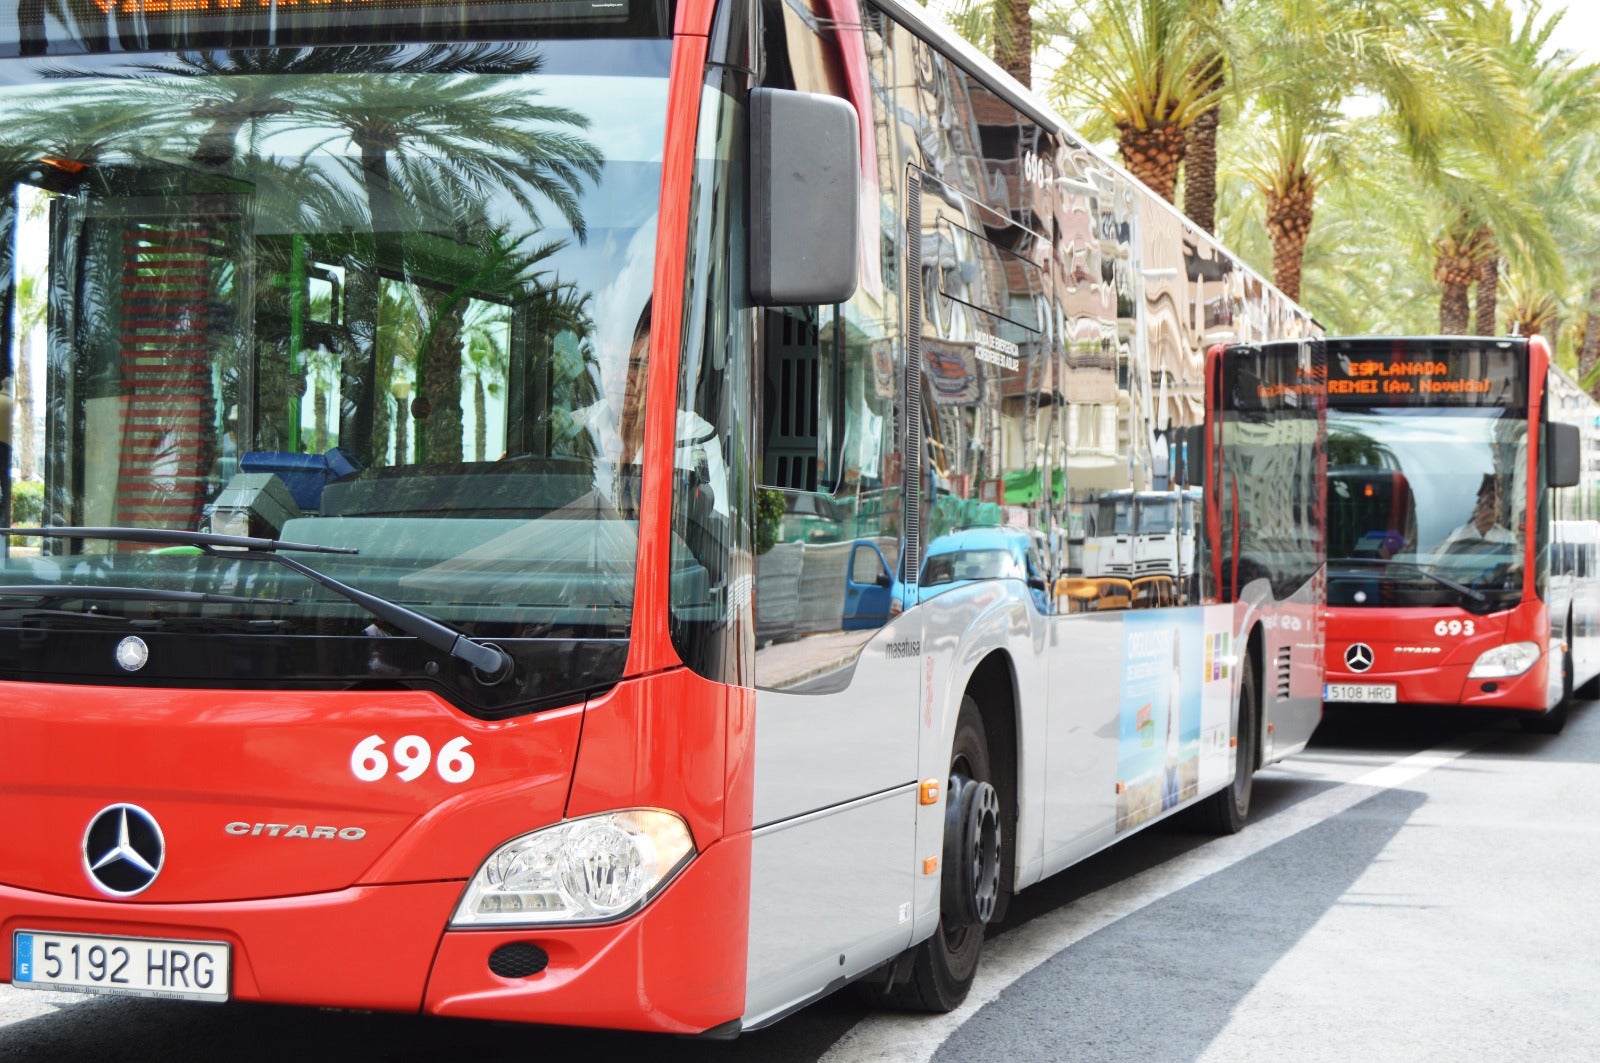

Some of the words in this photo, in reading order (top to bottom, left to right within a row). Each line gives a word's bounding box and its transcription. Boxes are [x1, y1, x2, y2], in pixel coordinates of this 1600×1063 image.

[1024, 150, 1044, 189] 696
[1348, 361, 1447, 376] ESPLANADA
[1328, 380, 1378, 393] REMEI
[1384, 380, 1414, 393] (Av.
[1419, 379, 1490, 393] Novelda)
[1434, 619, 1475, 636] 693
[886, 637, 920, 660] masatusa
[1331, 686, 1363, 699] 5108
[1368, 687, 1392, 699] HRG
[351, 734, 475, 783] 696
[225, 821, 366, 840] CITARO
[20, 963, 29, 974] E
[44, 941, 130, 984] 5192
[147, 948, 215, 989] HRG
